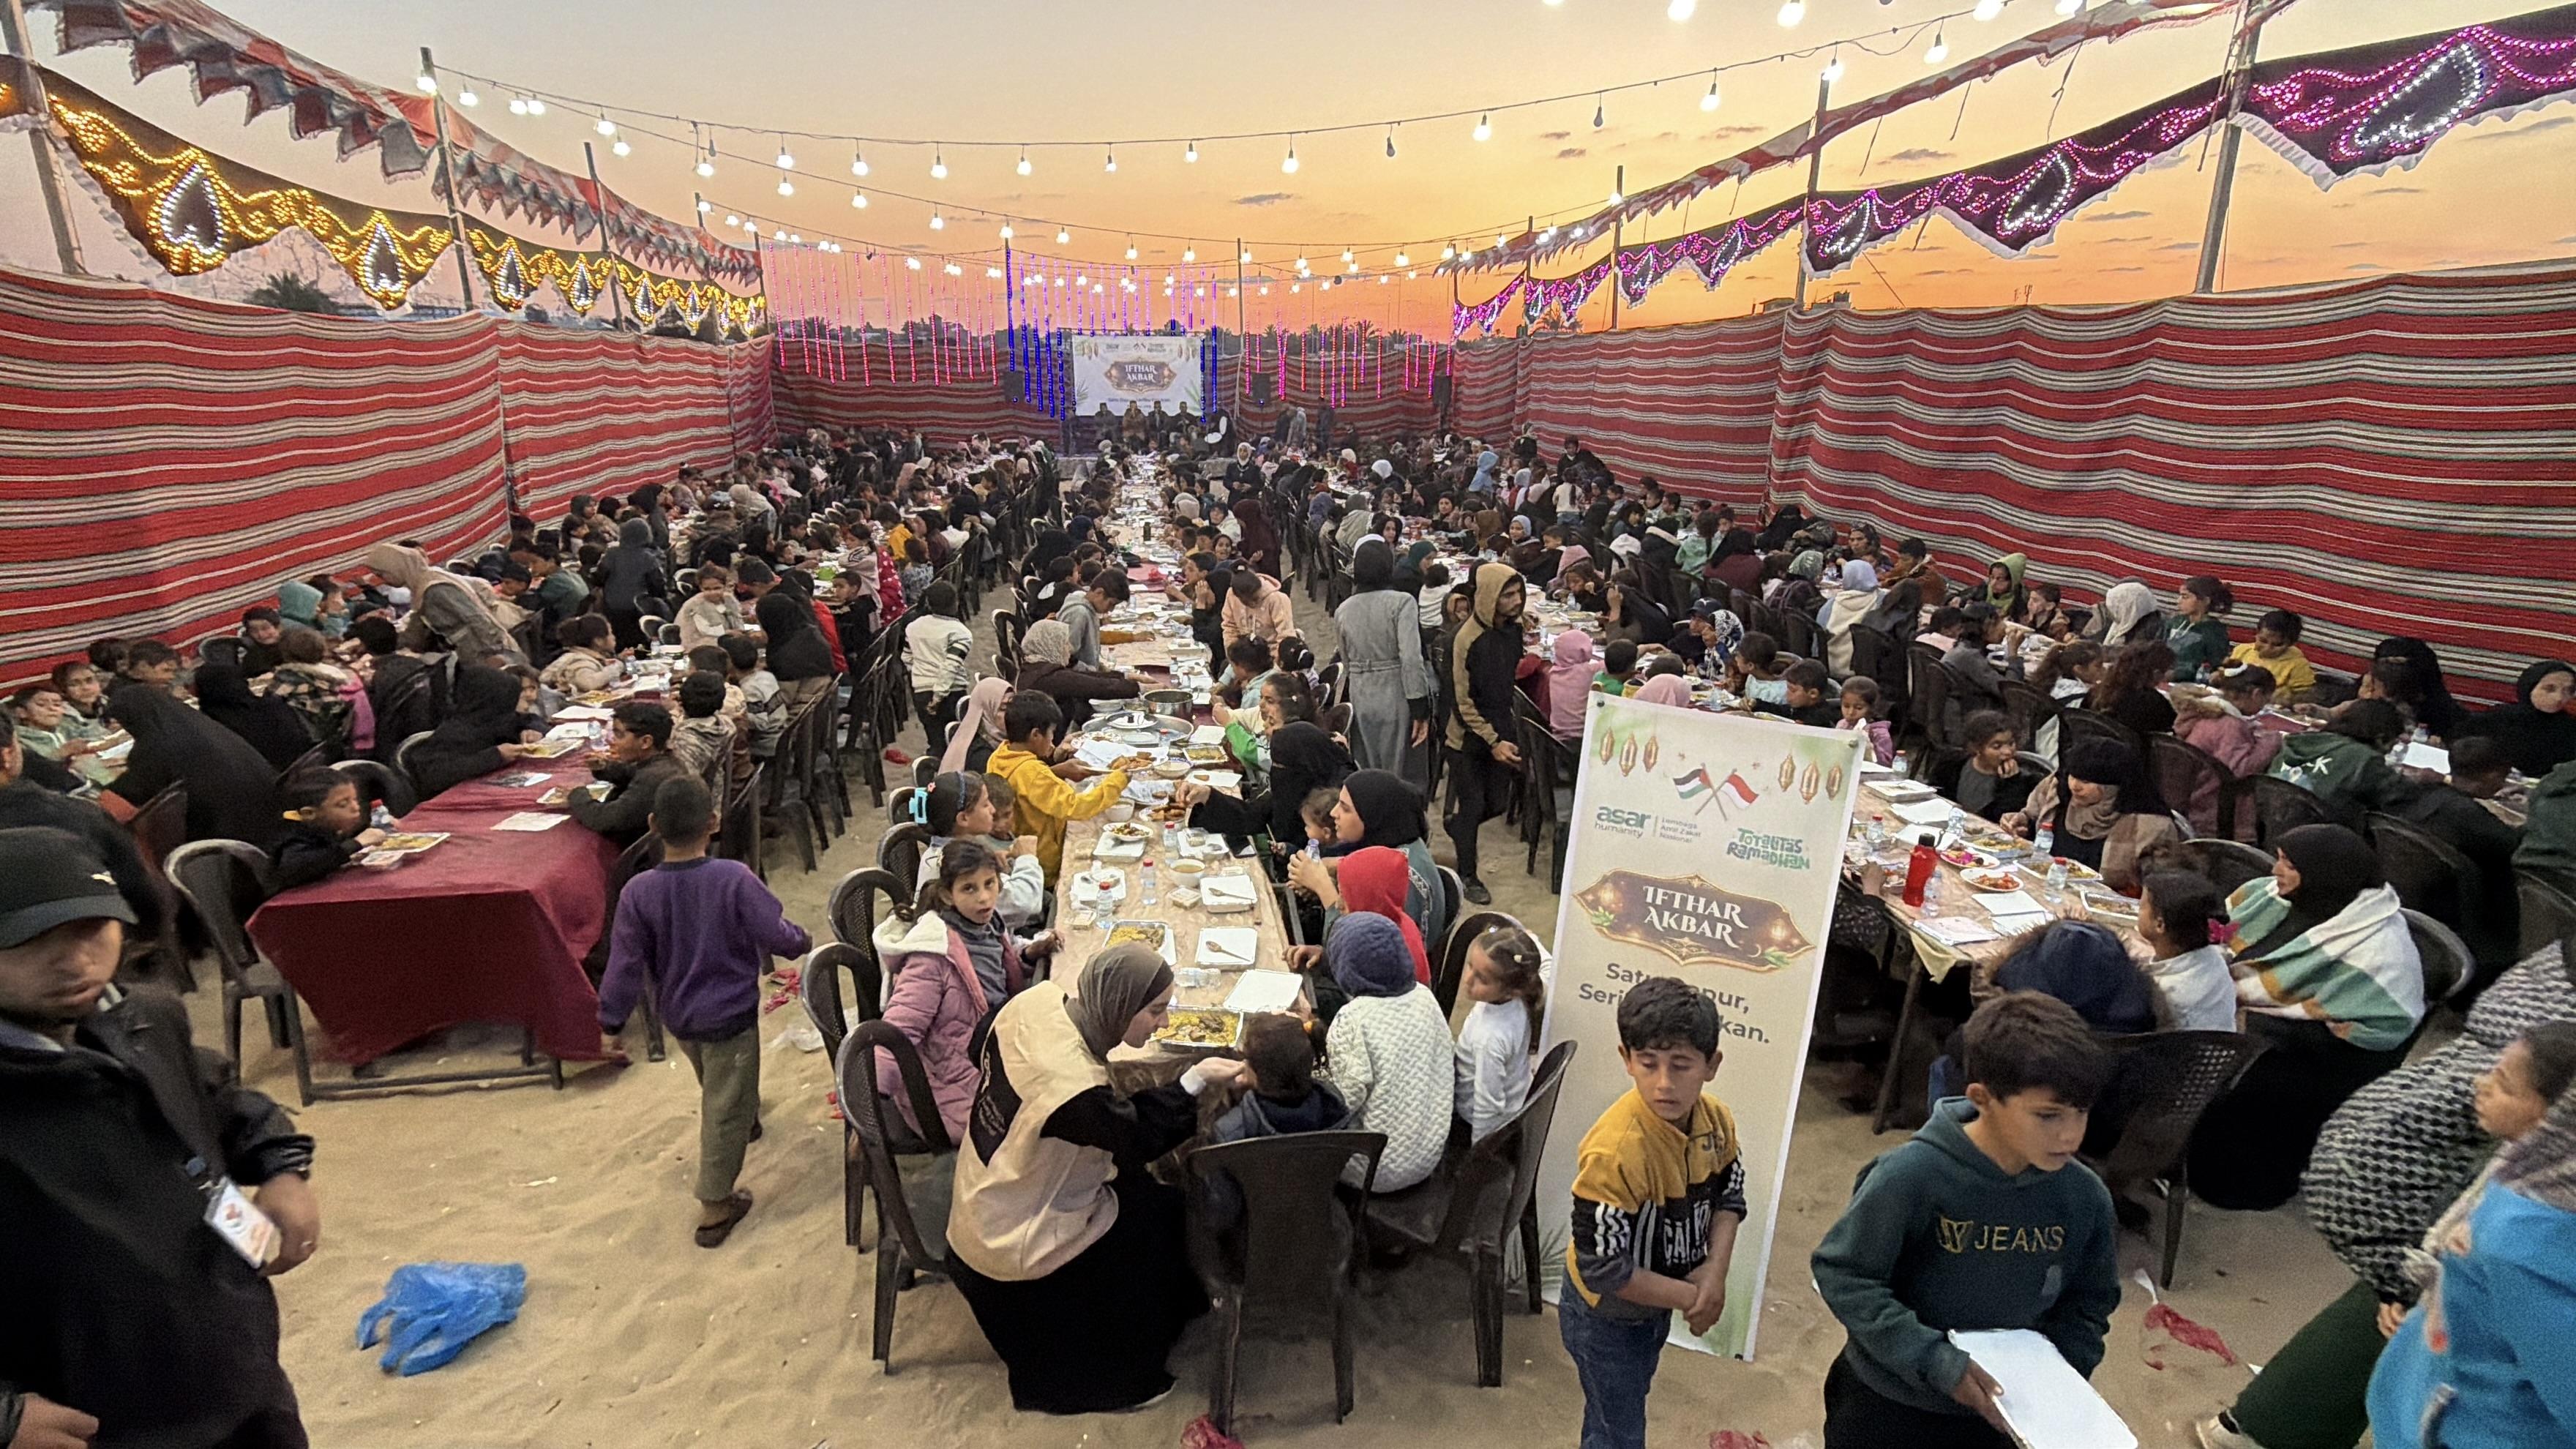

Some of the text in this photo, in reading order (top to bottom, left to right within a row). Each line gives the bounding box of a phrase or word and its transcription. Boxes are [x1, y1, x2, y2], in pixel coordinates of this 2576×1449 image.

[1125, 364, 1158, 374] IFTHAR
[1596, 806, 1652, 828] asar
[1595, 820, 1644, 839] humanity
[1643, 886, 1749, 929] IFTHAR
[1644, 906, 1742, 949] AKBAR
[1974, 1225, 2065, 1252] JEANS
